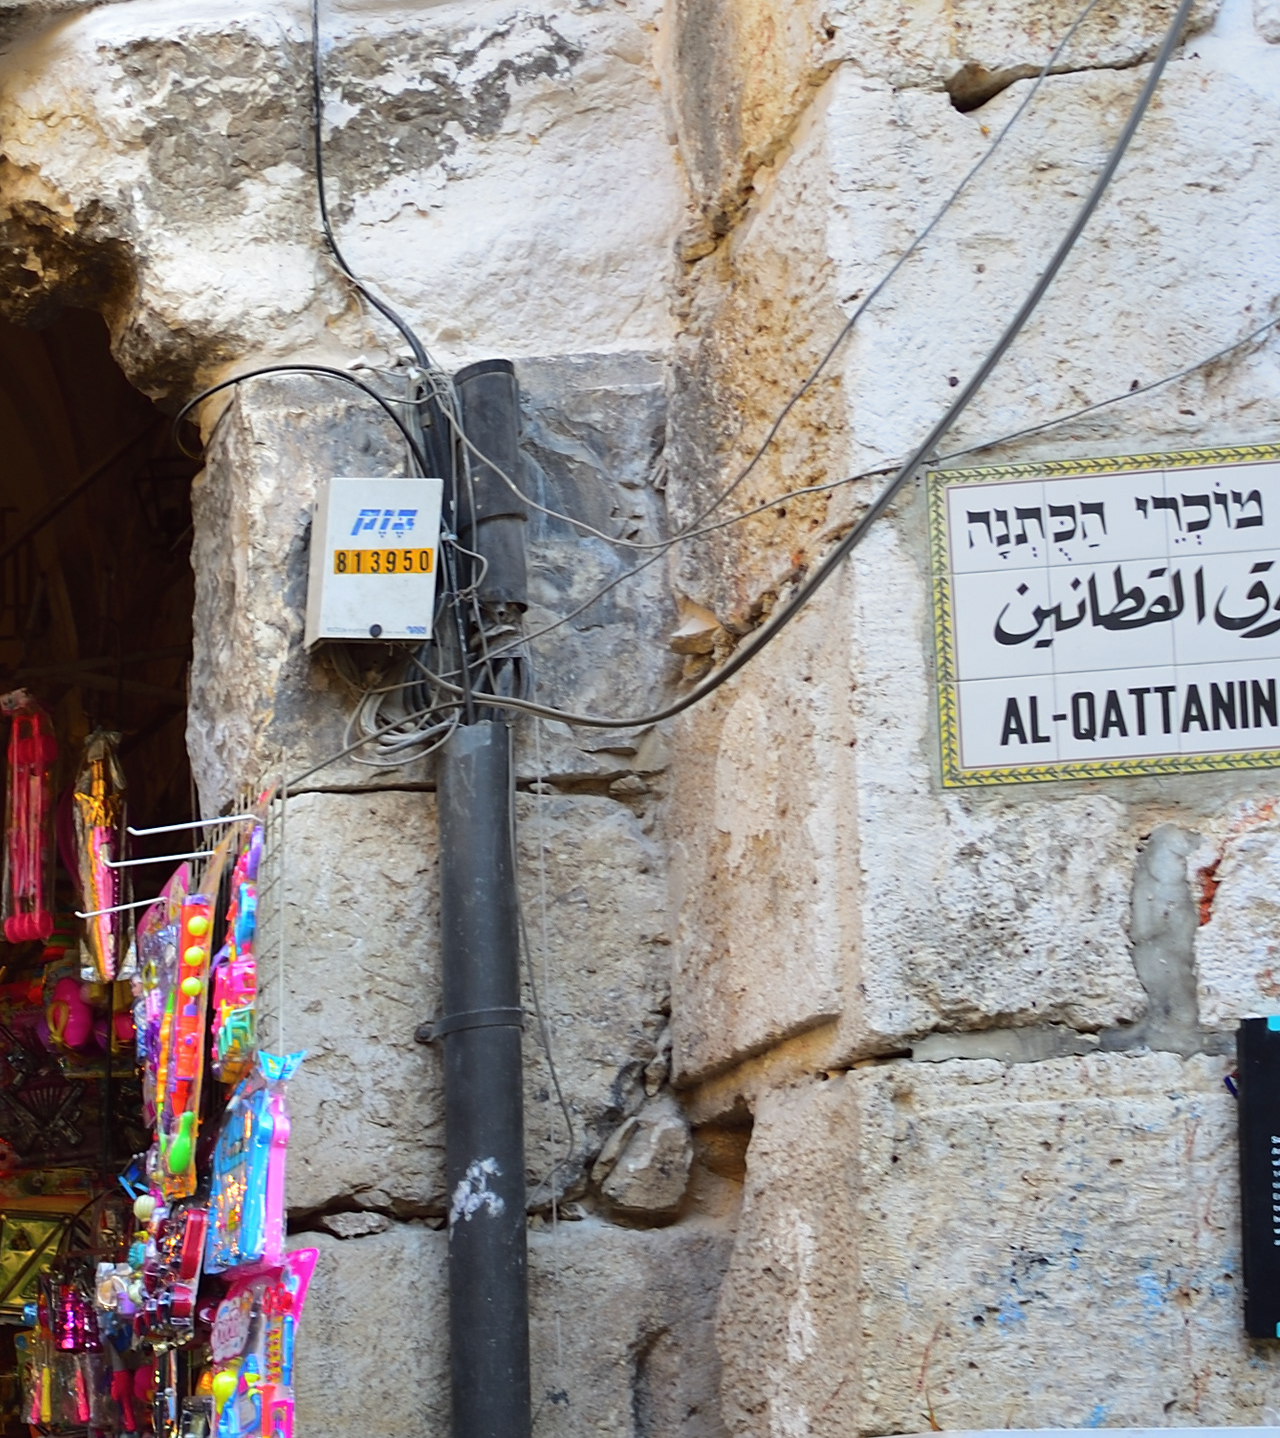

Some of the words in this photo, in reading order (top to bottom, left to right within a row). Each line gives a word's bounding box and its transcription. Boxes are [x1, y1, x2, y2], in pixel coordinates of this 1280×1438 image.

[336, 550, 430, 573] 813950
[993, 564, 1205, 649] القطانين
[1000, 677, 1278, 746] AL-QATTANIN
